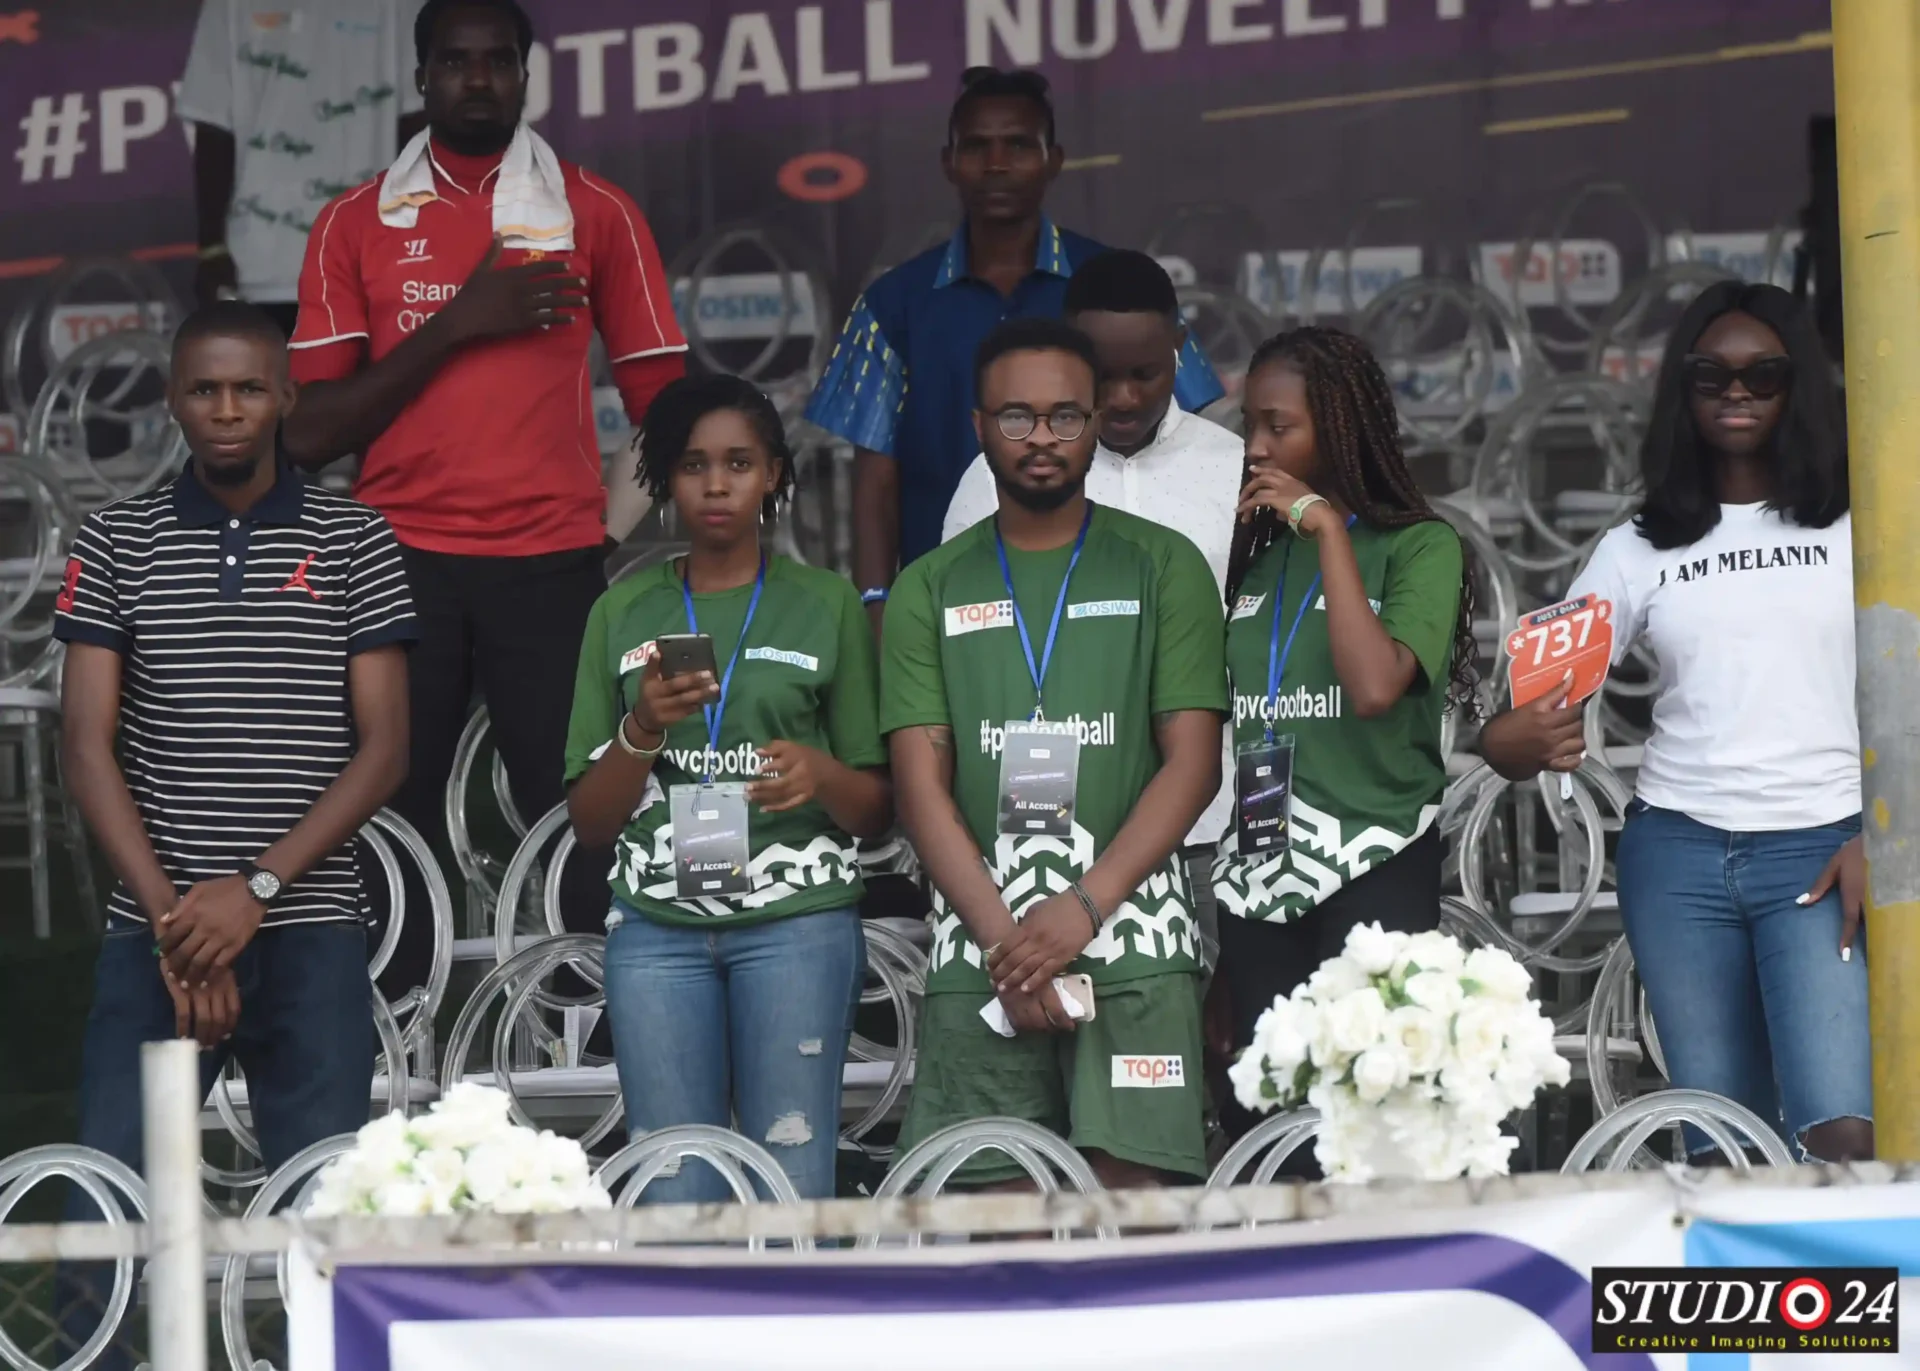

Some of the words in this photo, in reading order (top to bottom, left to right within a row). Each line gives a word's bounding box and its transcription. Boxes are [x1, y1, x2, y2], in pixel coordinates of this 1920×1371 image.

[402, 280, 463, 303] Stan
[1676, 558, 1709, 582] AM
[1718, 545, 1829, 574] MELANIN
[1090, 602, 1138, 616] OSIWA
[1537, 609, 1557, 623] JUST
[765, 649, 810, 669] OSIWA
[1014, 801, 1027, 810] All
[1029, 802, 1058, 811] Access
[1247, 820, 1257, 830] All
[1257, 817, 1279, 828] Access
[689, 863, 702, 872] All
[703, 862, 732, 871] Access
